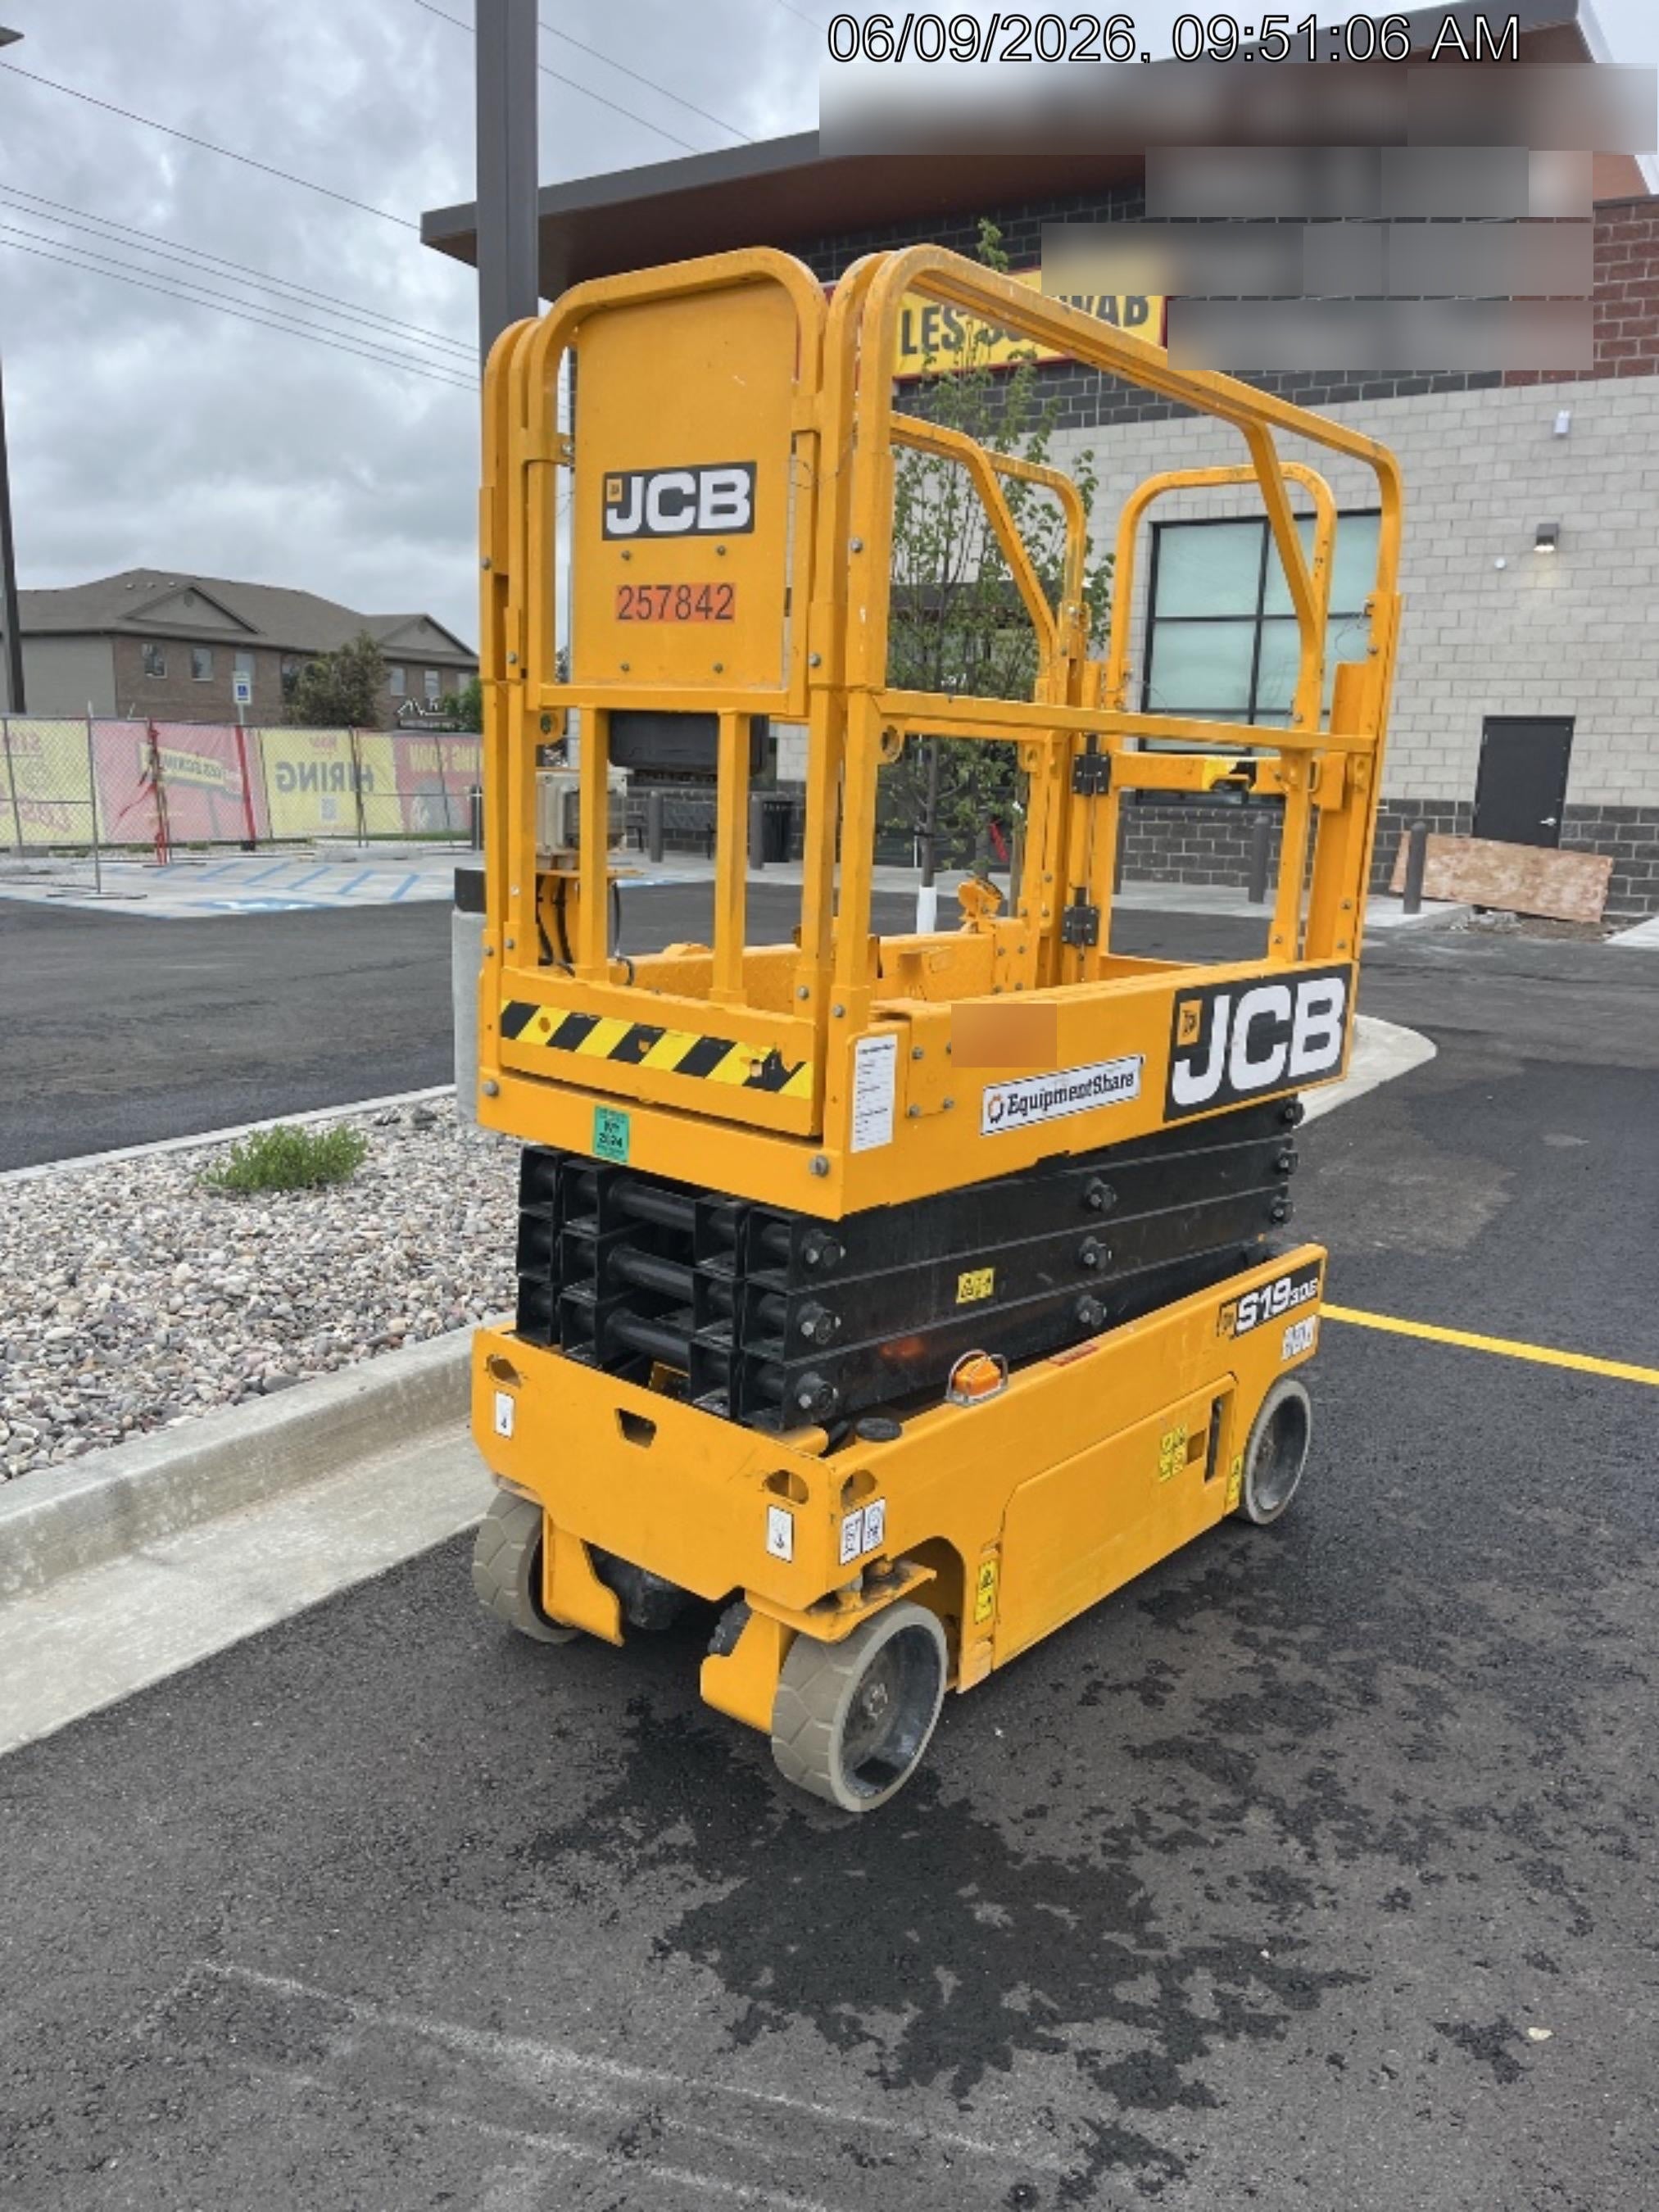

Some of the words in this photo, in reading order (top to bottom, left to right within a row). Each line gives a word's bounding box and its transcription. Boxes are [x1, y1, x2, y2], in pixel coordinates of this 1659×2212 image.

[901, 304, 965, 355] LES
[606, 469, 751, 534] JCB
[618, 584, 733, 620] 257842
[1172, 977, 1345, 1106] JCB
[1007, 1072, 1135, 1117] EquipmentShare
